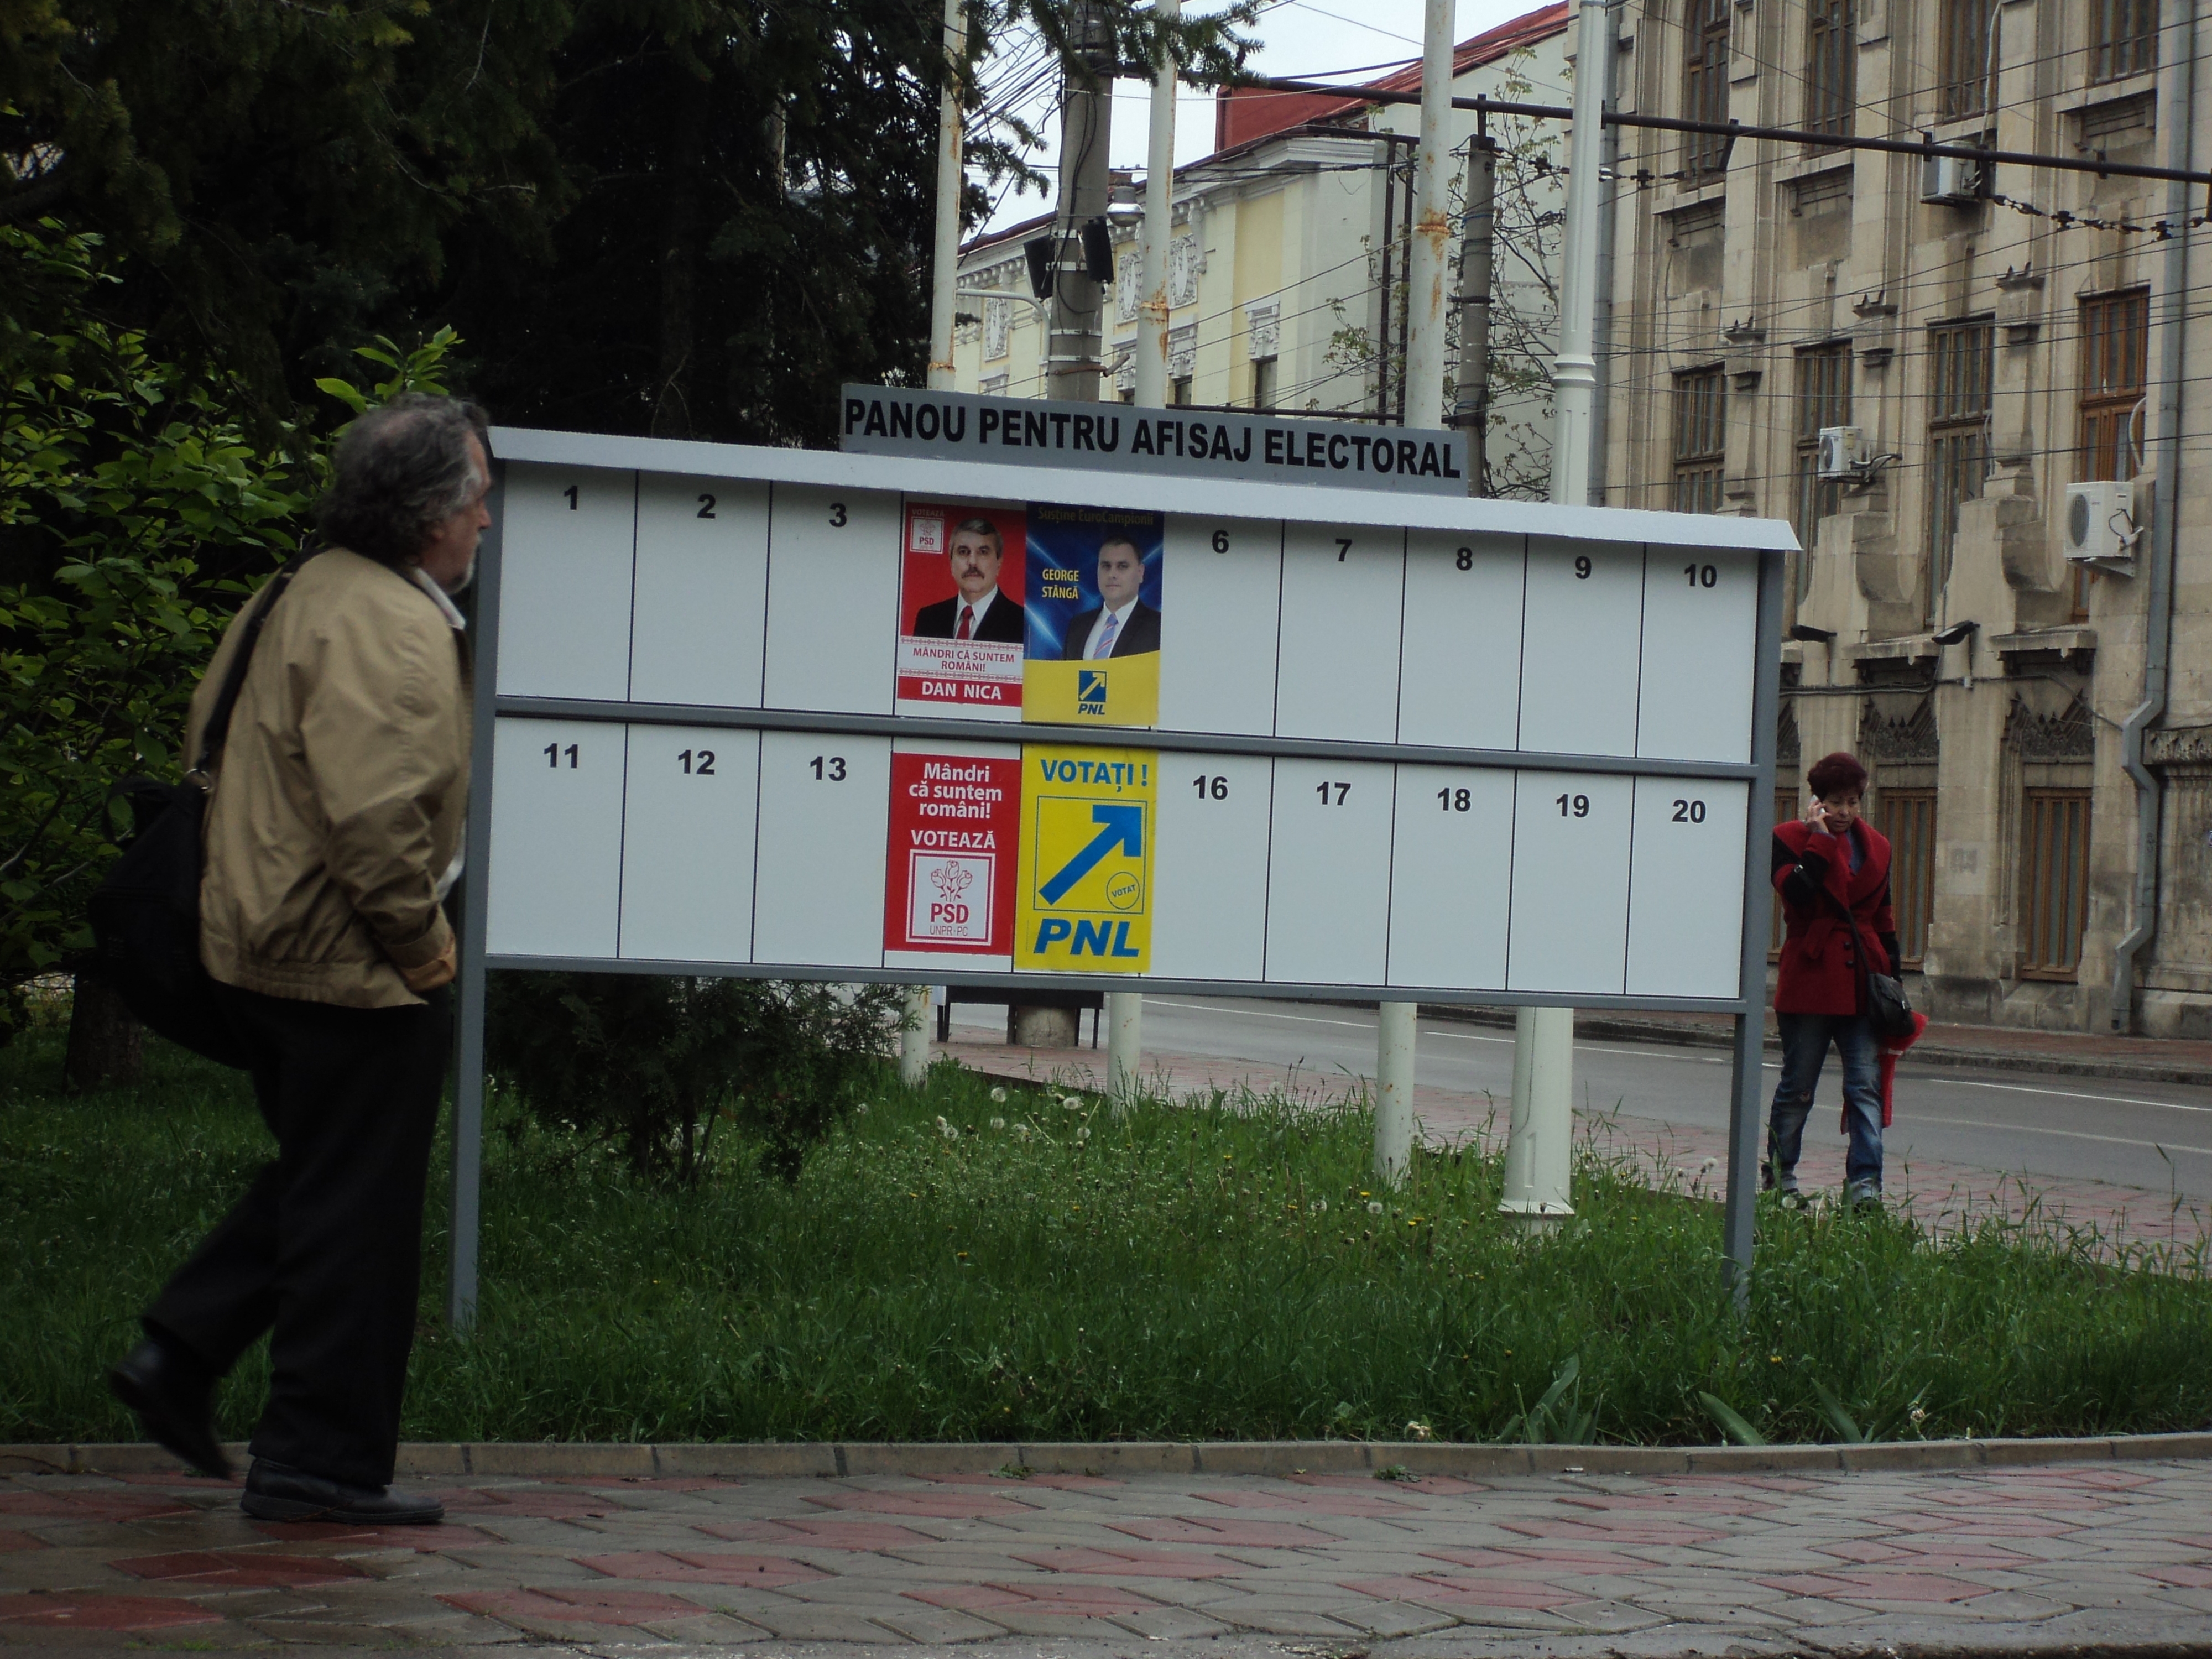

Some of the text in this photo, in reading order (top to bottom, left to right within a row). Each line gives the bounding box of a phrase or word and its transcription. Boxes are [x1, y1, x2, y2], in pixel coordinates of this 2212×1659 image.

[844, 395, 1460, 479] PANOU PENTRU AFISAJ ELECTORAL
[564, 485, 578, 511] 1
[697, 493, 716, 520] 2
[828, 500, 847, 528] 3
[1079, 509, 1154, 527] EuroCampionii
[919, 536, 935, 545] PSD
[1211, 529, 1230, 554] 6
[1334, 539, 1352, 562] 7
[1455, 547, 1473, 571] 8
[1574, 555, 1592, 580] 9
[1042, 568, 1079, 581] GEORGE
[1684, 562, 1718, 589] 10
[913, 647, 954, 659] MÂNDRI
[973, 651, 1014, 663] SUNTEM
[921, 681, 1002, 700] DAN NICA
[1078, 703, 1105, 715] PNL
[544, 743, 578, 769] 11
[678, 749, 715, 775] 12
[810, 756, 846, 781] 13
[924, 763, 990, 782] Mândri
[909, 780, 1002, 801] că suntem
[1193, 775, 1228, 800] 16
[1317, 781, 1351, 806] 17
[1438, 787, 1471, 812] 18
[919, 800, 990, 818] români!
[1557, 794, 1589, 818] 19
[1672, 799, 1706, 823] 20
[911, 830, 995, 849] VOTEAZĂ
[1112, 884, 1136, 898] VOTAT
[930, 903, 969, 924] PSD
[1034, 918, 1140, 957] PNL
